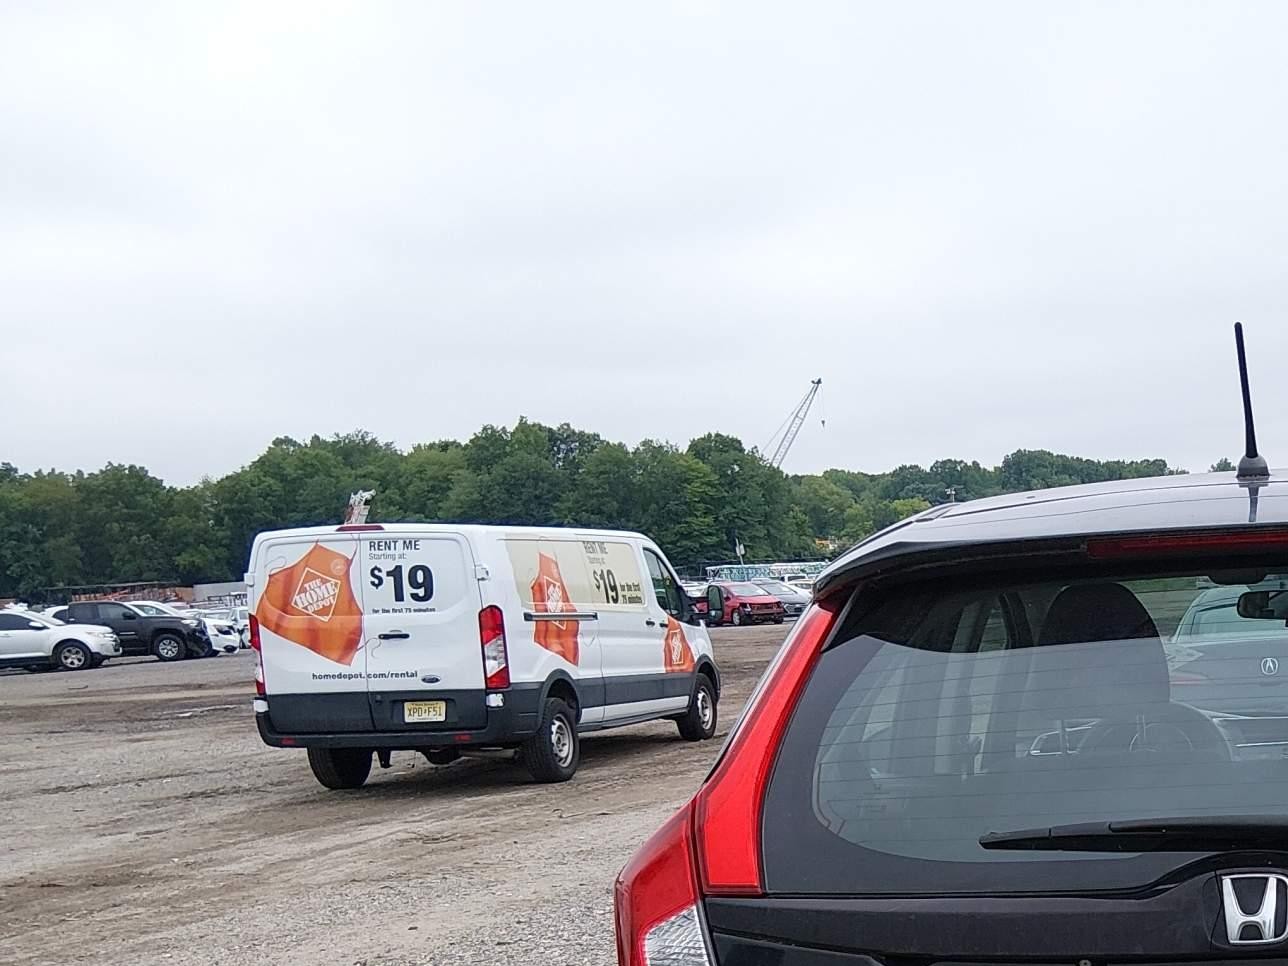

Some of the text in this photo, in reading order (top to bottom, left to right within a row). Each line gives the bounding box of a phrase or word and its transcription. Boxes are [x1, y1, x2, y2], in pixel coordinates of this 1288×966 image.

[369, 540, 420, 551] RENT ME
[369, 553, 396, 561] Starting
[304, 578, 321, 591] THE
[370, 564, 434, 602] $19
[593, 569, 619, 604] $19
[295, 580, 337, 608] HOME
[308, 596, 334, 612] DEPOT
[312, 670, 418, 680] homedepot.com/rental
